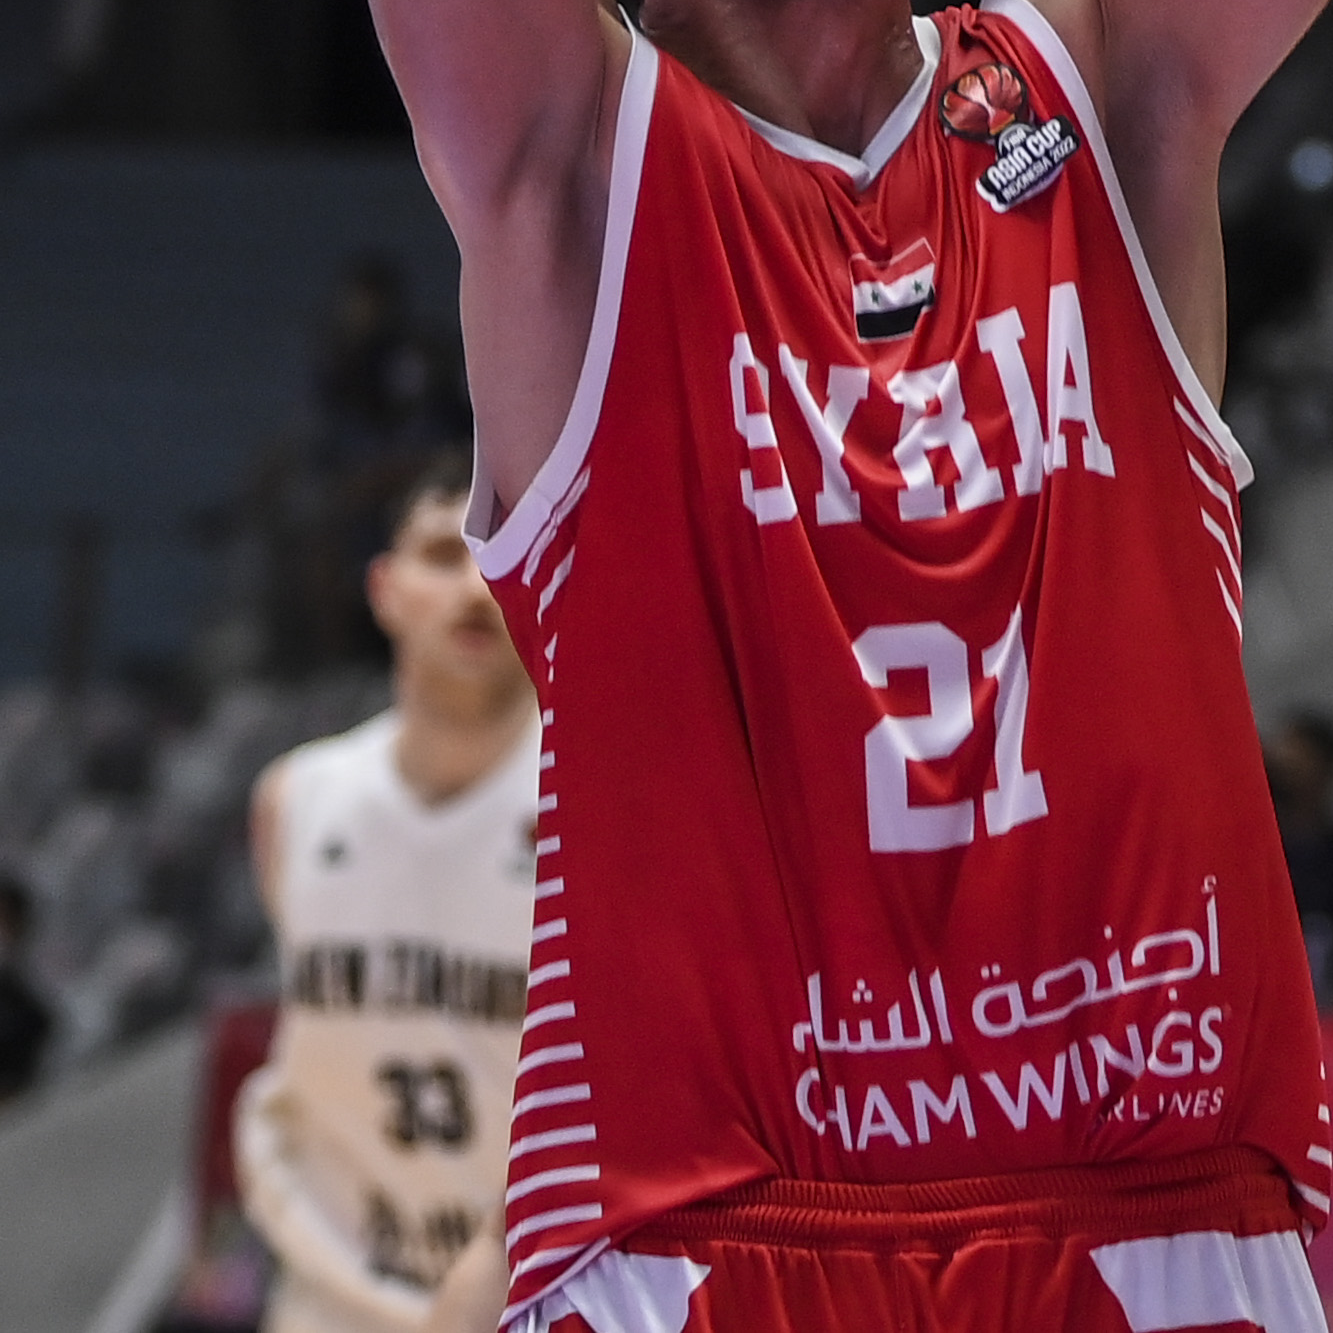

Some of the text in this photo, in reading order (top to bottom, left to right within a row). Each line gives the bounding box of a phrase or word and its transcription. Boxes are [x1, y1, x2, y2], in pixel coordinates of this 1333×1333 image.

[987, 118, 1061, 190] ASIA CUP
[729, 282, 1116, 525] SYRIA
[852, 602, 1048, 852] 21
[374, 1057, 475, 1153] 33
[980, 1006, 1223, 1131] WINGS
